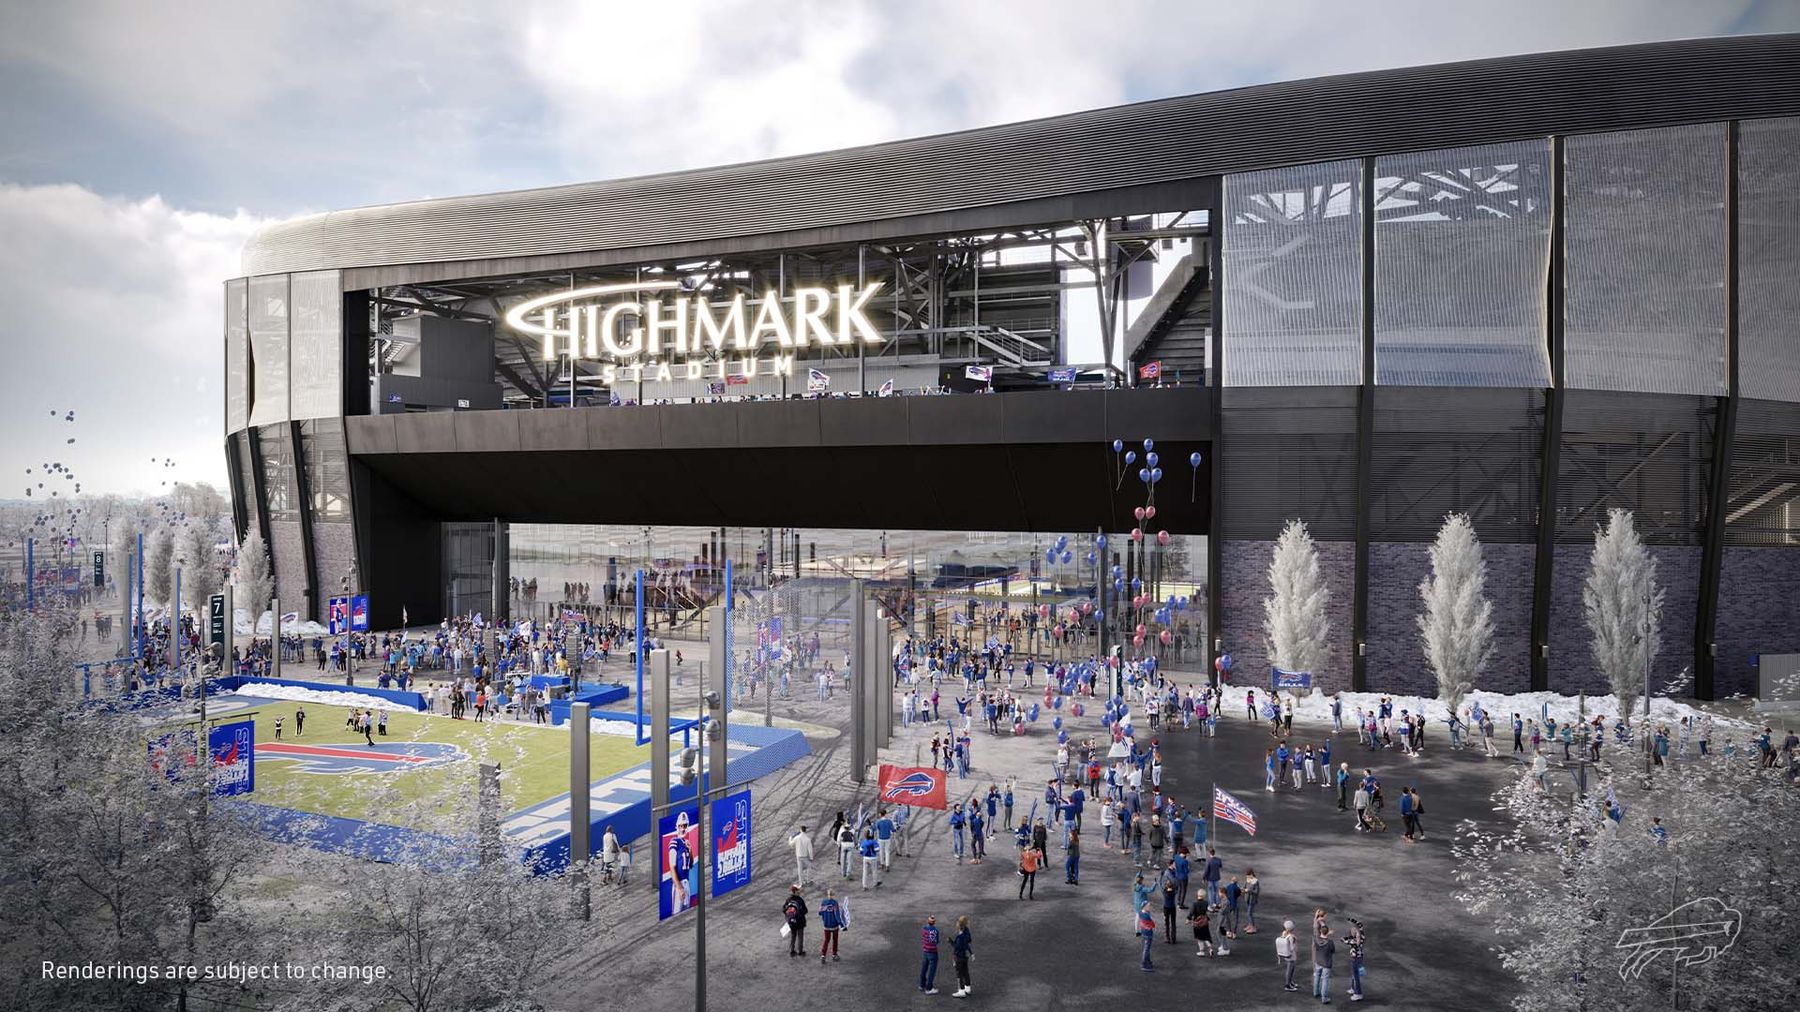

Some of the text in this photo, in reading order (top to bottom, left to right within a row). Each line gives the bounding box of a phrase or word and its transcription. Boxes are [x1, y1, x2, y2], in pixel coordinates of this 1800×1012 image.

[543, 282, 887, 360] HIGHMARK
[603, 356, 793, 384] STADIUM
[213, 602, 221, 614] 7
